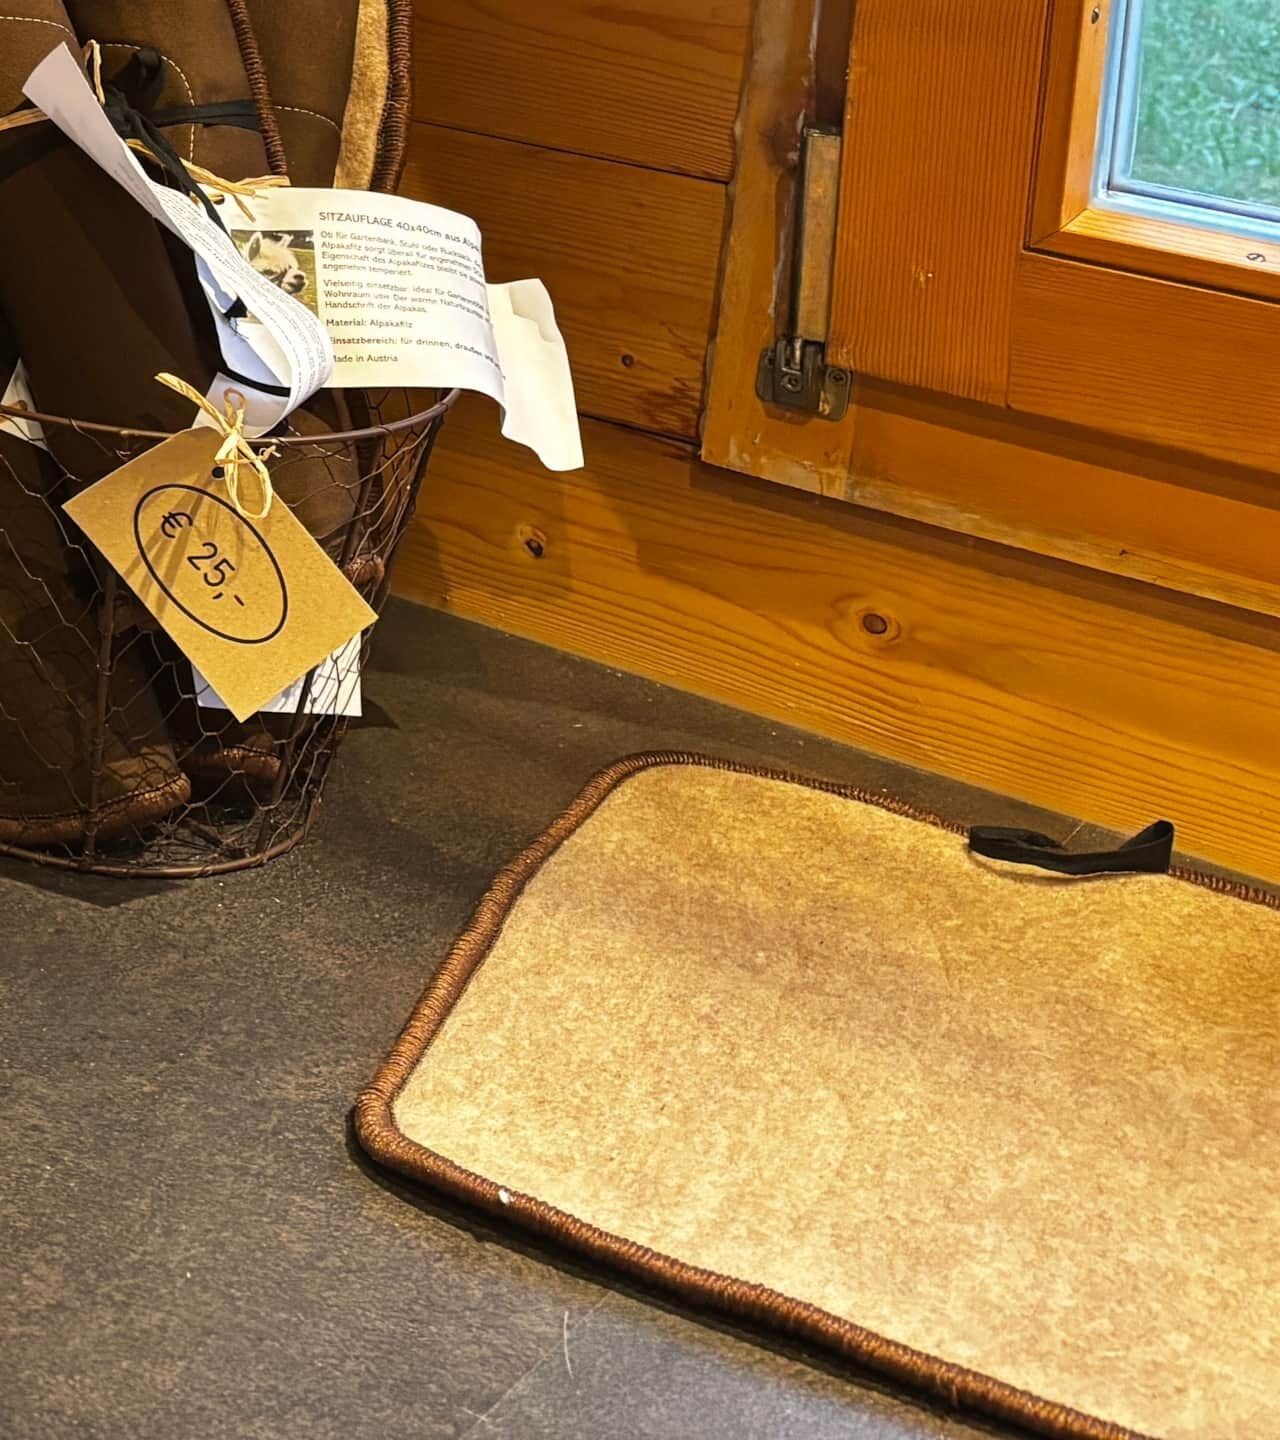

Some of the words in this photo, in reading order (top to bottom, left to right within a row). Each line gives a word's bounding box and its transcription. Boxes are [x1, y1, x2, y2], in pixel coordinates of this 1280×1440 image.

[319, 212, 393, 228] SITZAUFLAGE
[396, 222, 442, 237] 40x40cm
[445, 233, 461, 243] aus
[370, 319, 413, 328] Alpakafilz
[356, 354, 364, 362] in
[367, 354, 398, 363] Austria
[161, 512, 193, 538] €
[187, 542, 244, 606] 25,-
